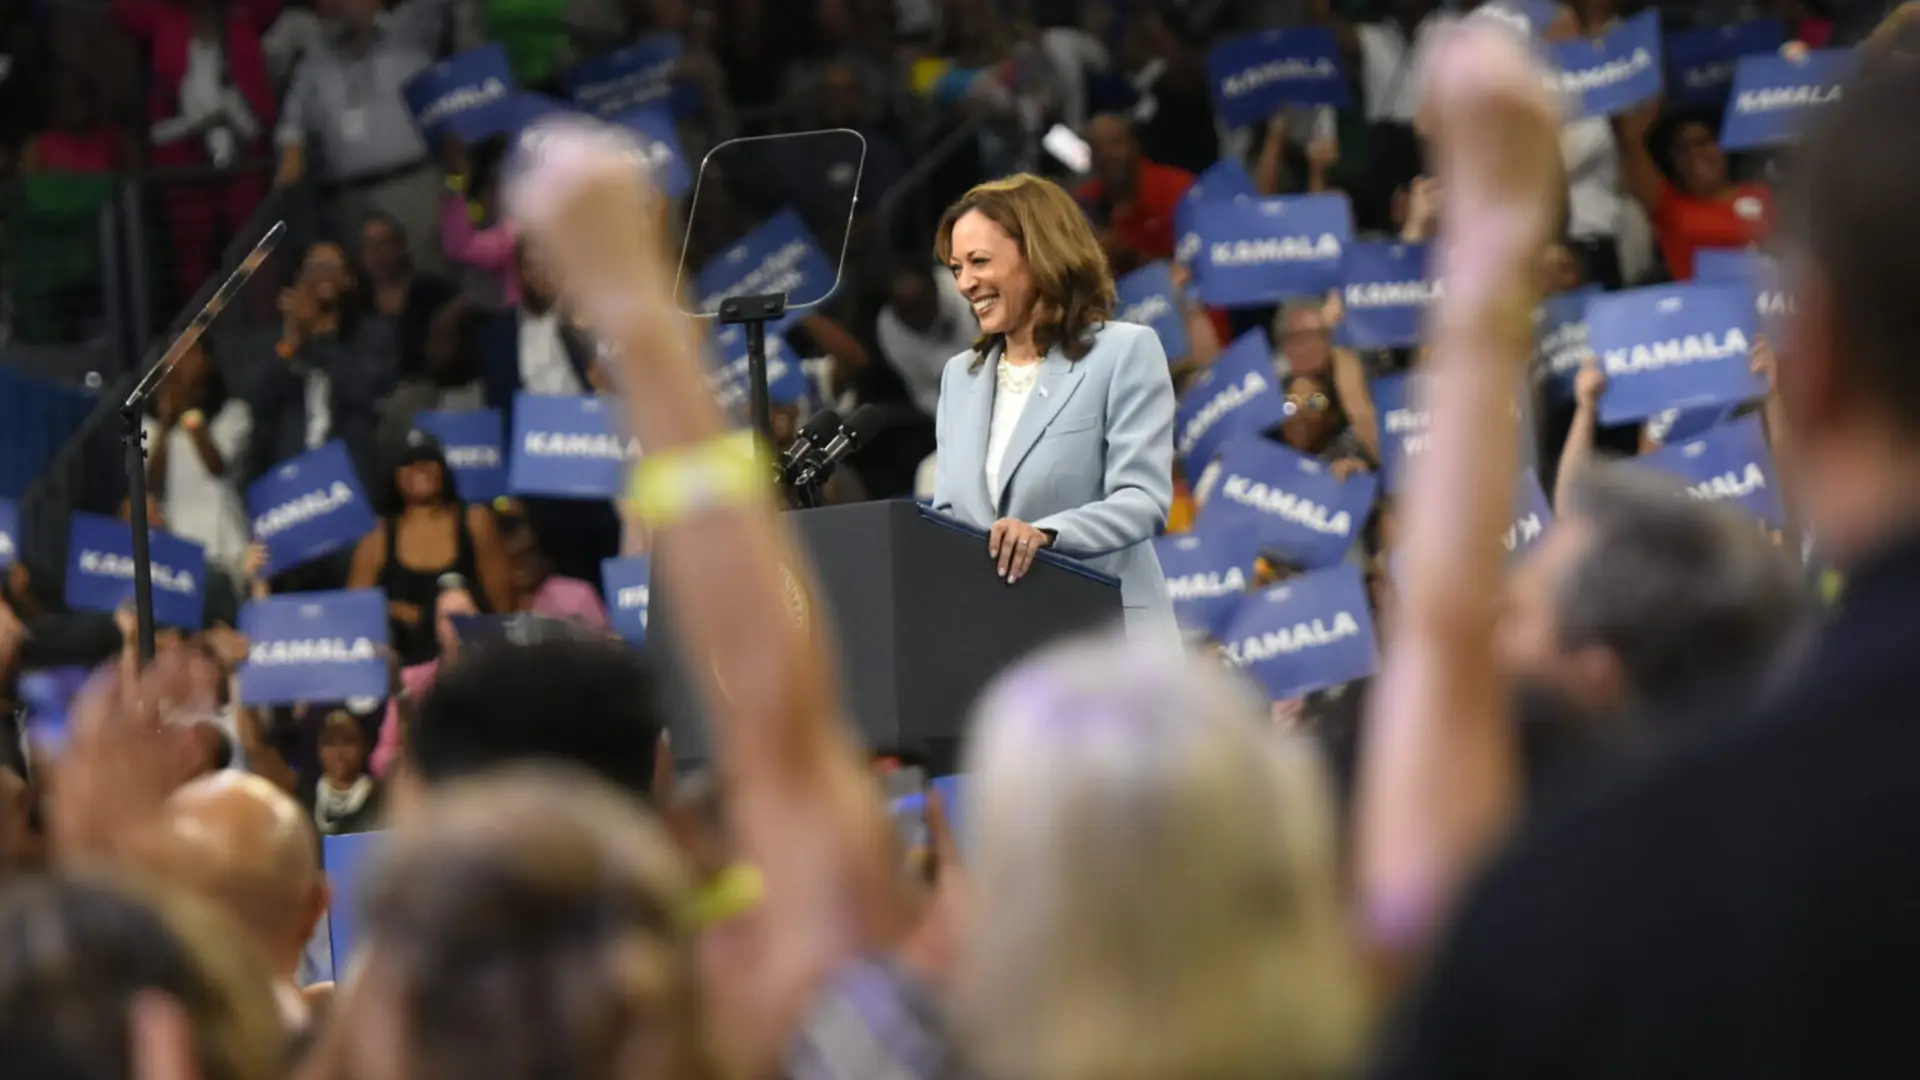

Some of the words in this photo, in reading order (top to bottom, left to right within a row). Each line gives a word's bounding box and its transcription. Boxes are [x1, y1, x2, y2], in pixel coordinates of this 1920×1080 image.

[1210, 232, 1342, 267] KAMALA
[1602, 326, 1750, 376] KAMALA
[253, 480, 354, 536] KAMALA
[1222, 472, 1352, 538] KAMALA
[249, 636, 375, 667] KAMALA
[1219, 611, 1361, 668] KAMALA
